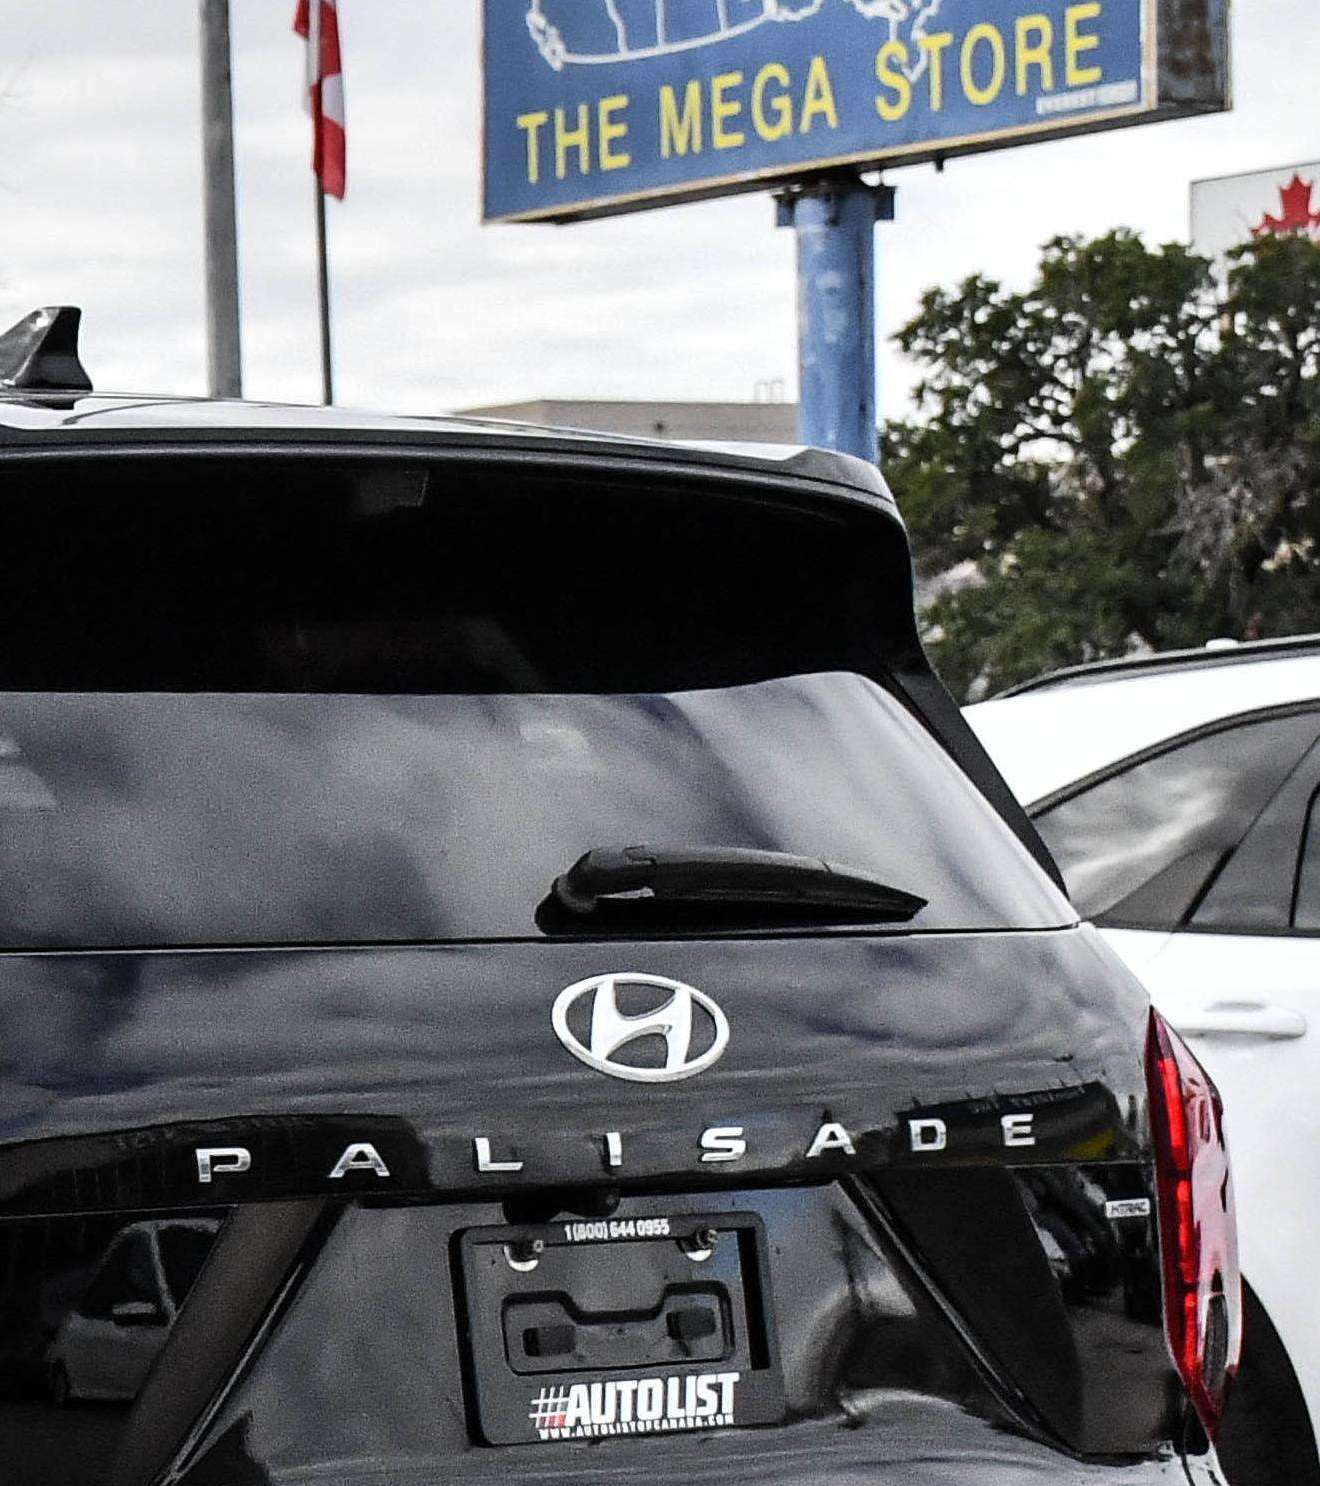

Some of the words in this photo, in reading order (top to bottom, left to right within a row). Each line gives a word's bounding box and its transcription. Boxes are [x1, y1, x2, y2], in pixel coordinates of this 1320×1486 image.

[516, 95, 631, 184] THE
[660, 55, 839, 160] MEGA
[874, 2, 1102, 121] STORE
[195, 1112, 1036, 1183] PALISADE
